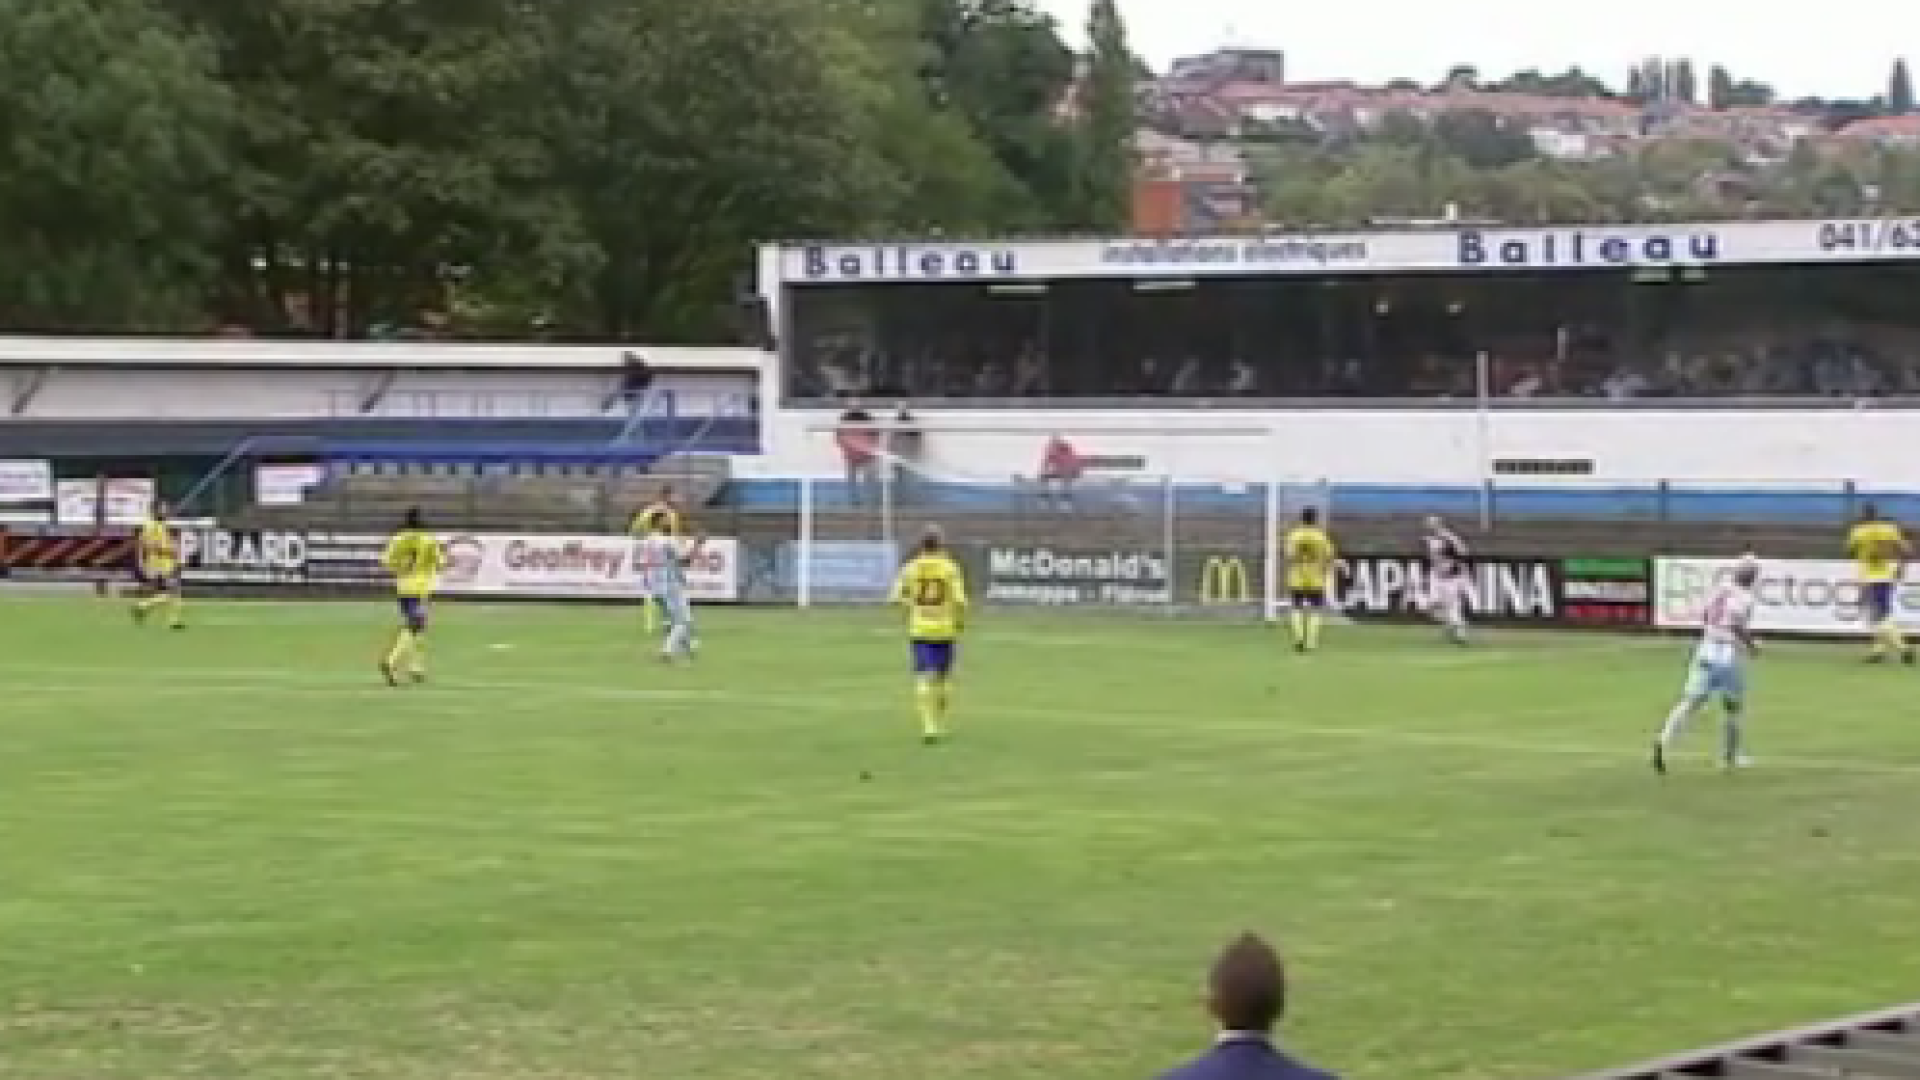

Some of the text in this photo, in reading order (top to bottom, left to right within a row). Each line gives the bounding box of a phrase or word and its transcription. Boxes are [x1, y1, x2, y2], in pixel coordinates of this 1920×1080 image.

[180, 528, 306, 571] PIRARD
[504, 540, 625, 579] Geoffrey
[989, 547, 1169, 579] McDonald's
